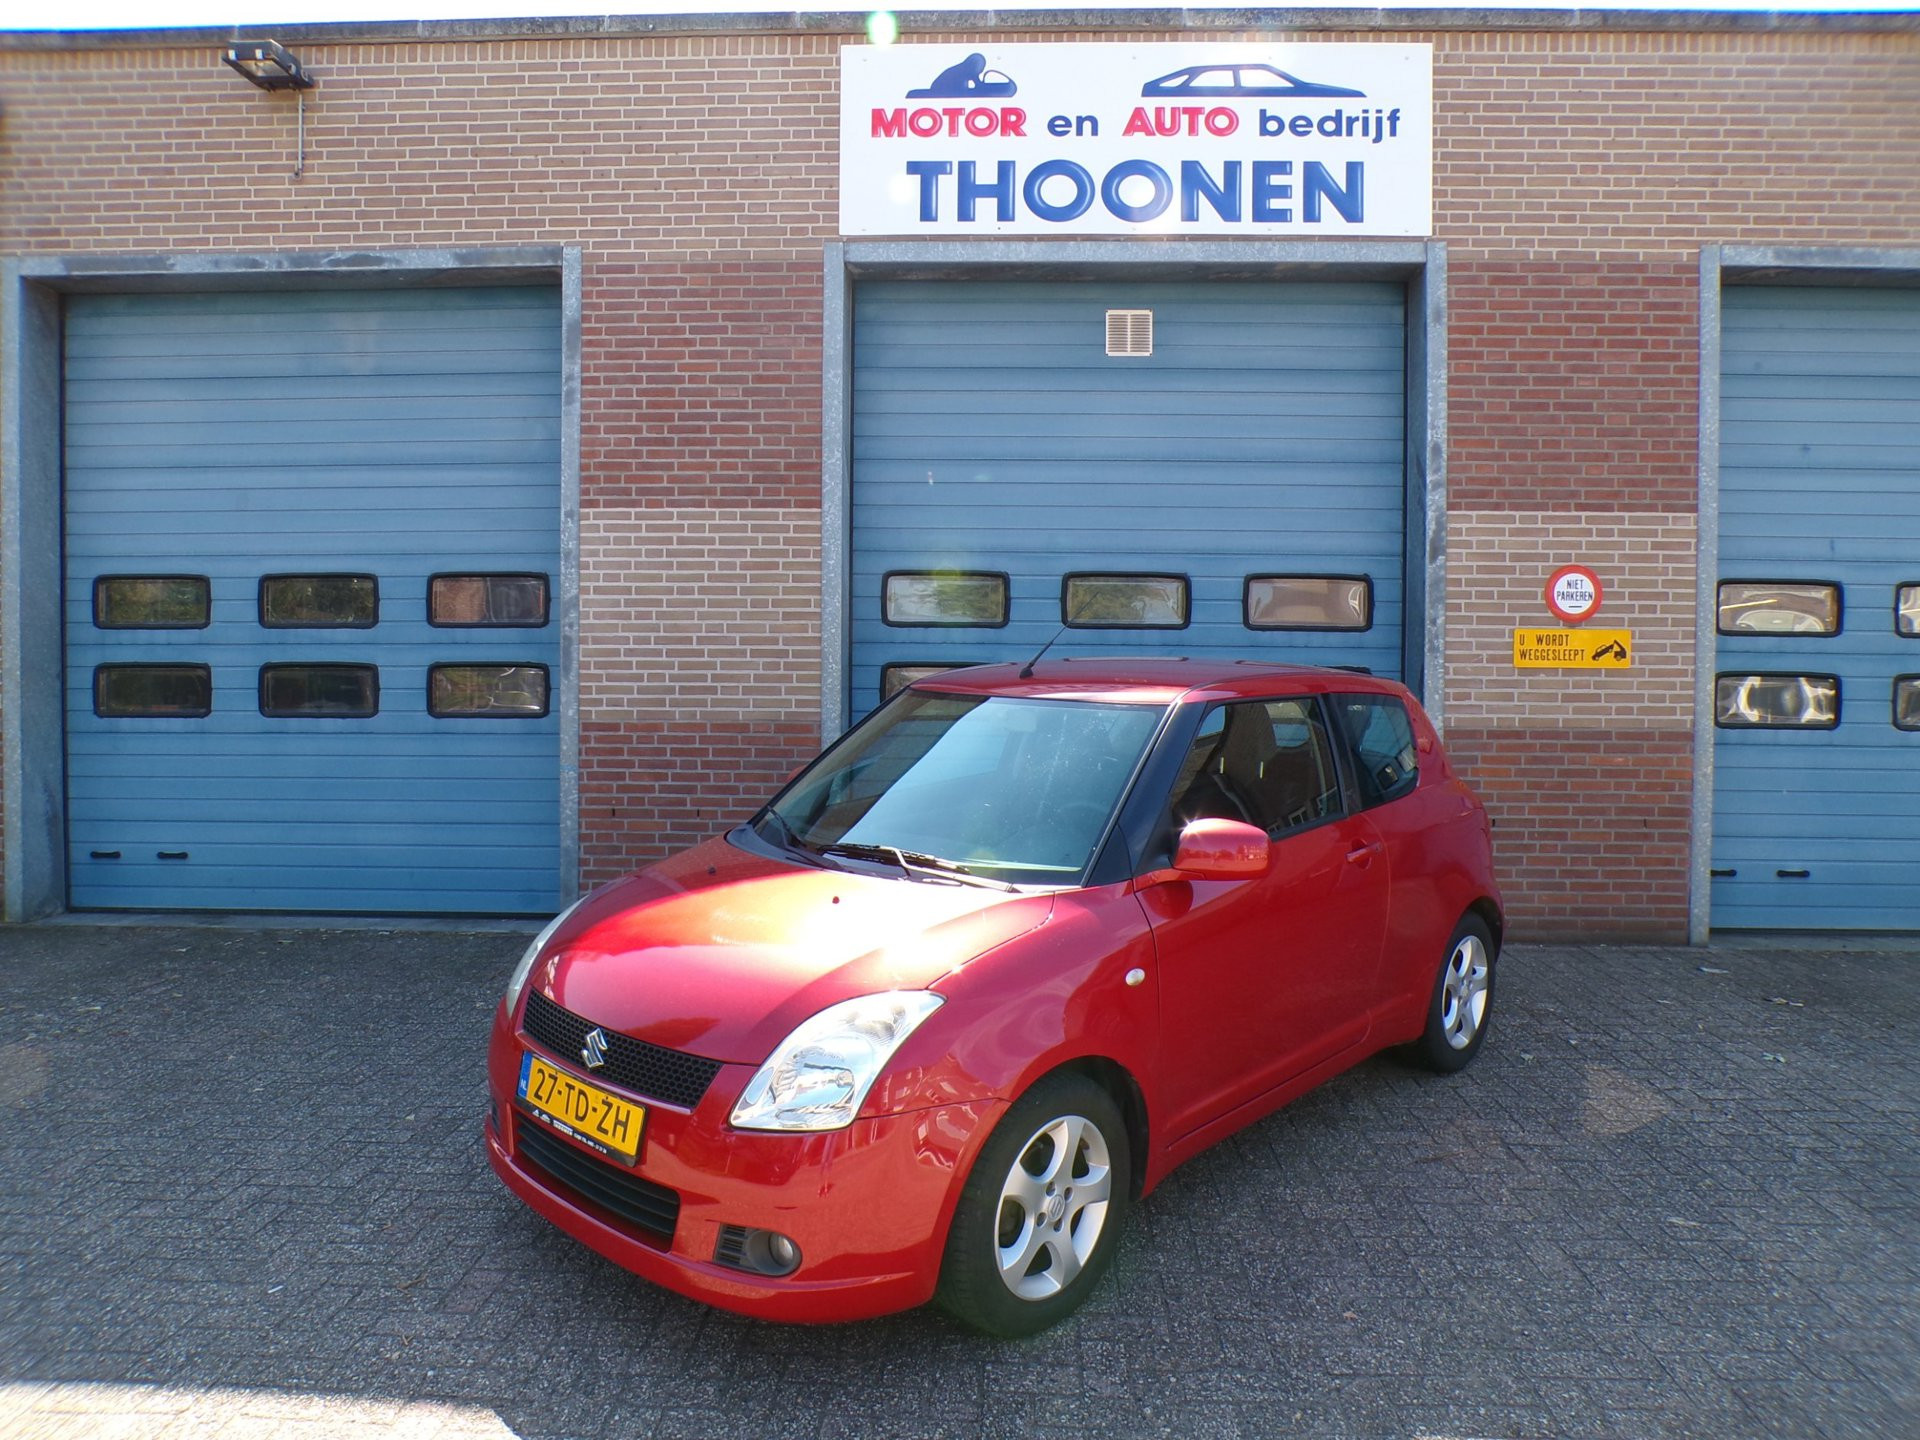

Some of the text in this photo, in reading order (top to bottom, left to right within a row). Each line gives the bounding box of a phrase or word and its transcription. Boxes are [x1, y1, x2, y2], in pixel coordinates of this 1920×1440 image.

[871, 106, 1401, 144] MOTOR en AUTO bedrijf
[905, 159, 1365, 223] THOONEN
[1566, 579, 1584, 590] NIET
[1556, 591, 1594, 601] PARKEREN
[1519, 634, 1570, 646] U WORDT
[1519, 649, 1585, 661] WEGGESLEEPT
[533, 1067, 631, 1143] 27-TD-ZH
